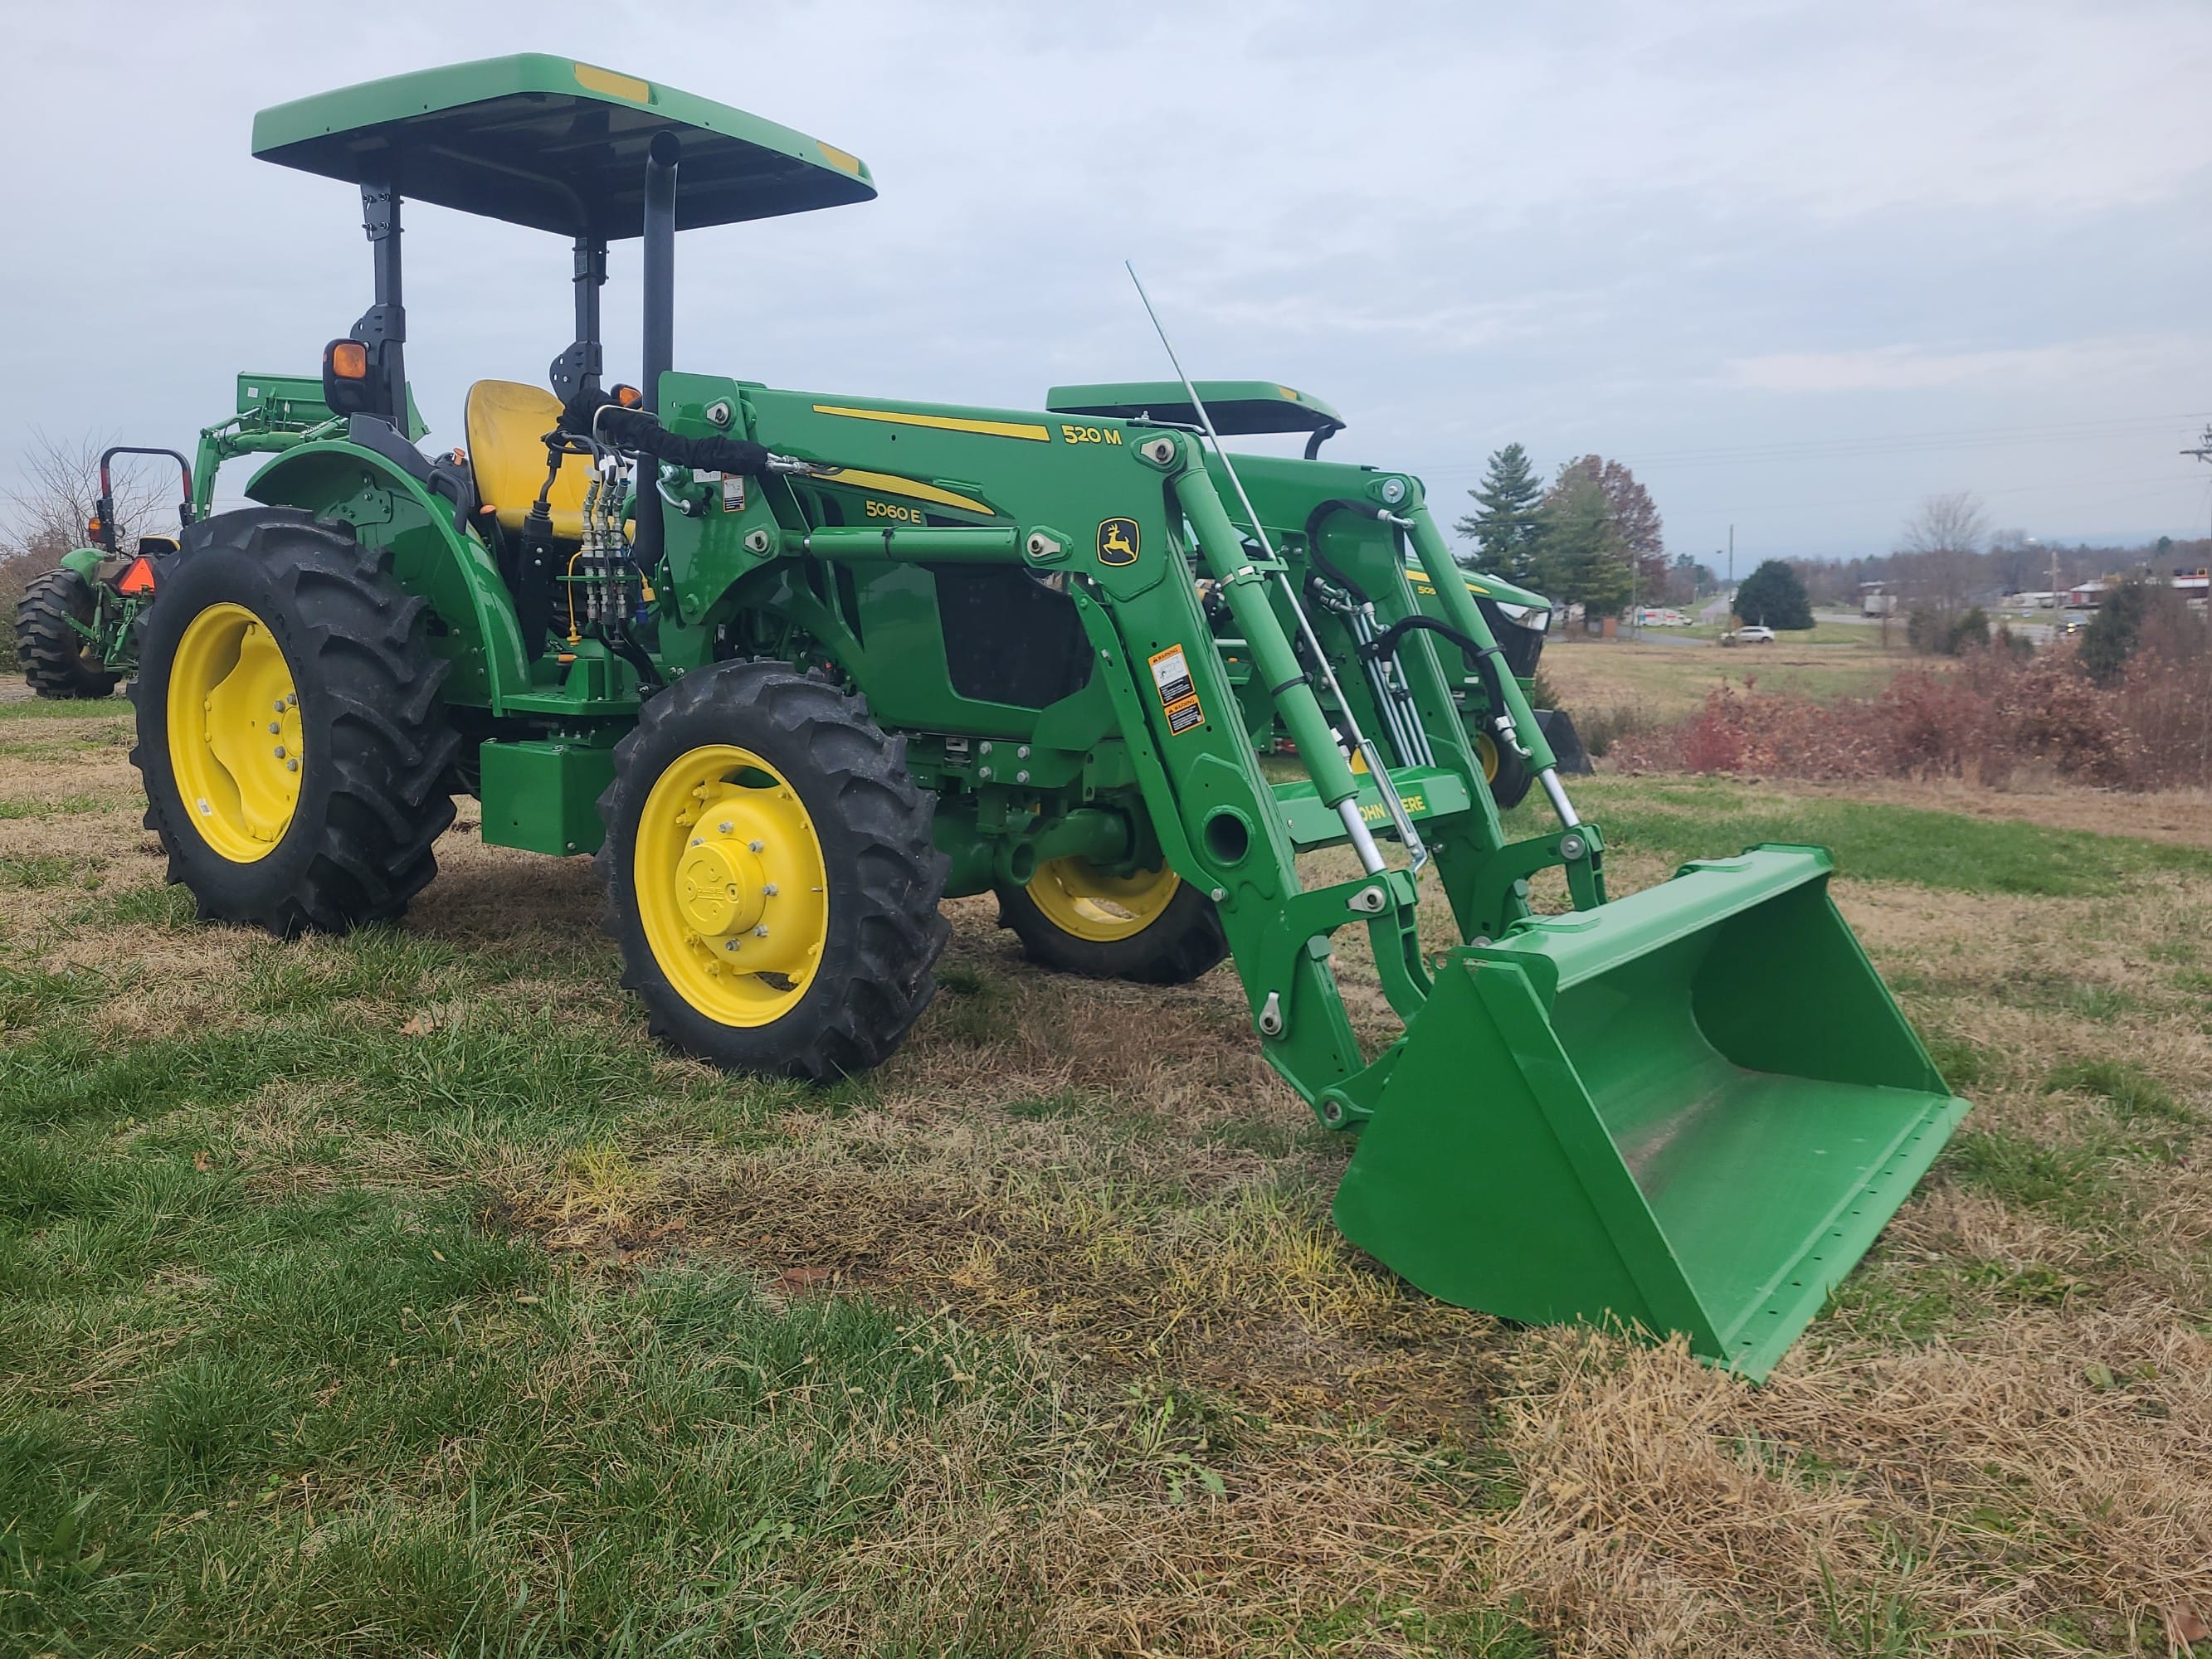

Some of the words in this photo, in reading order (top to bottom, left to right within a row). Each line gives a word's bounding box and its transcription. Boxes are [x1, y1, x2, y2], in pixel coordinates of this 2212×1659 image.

[1061, 425, 1102, 444] 520
[1103, 428, 1123, 445] M
[865, 499, 909, 521] 5060
[910, 509, 922, 524] E
[1358, 803, 1386, 821] OHN
